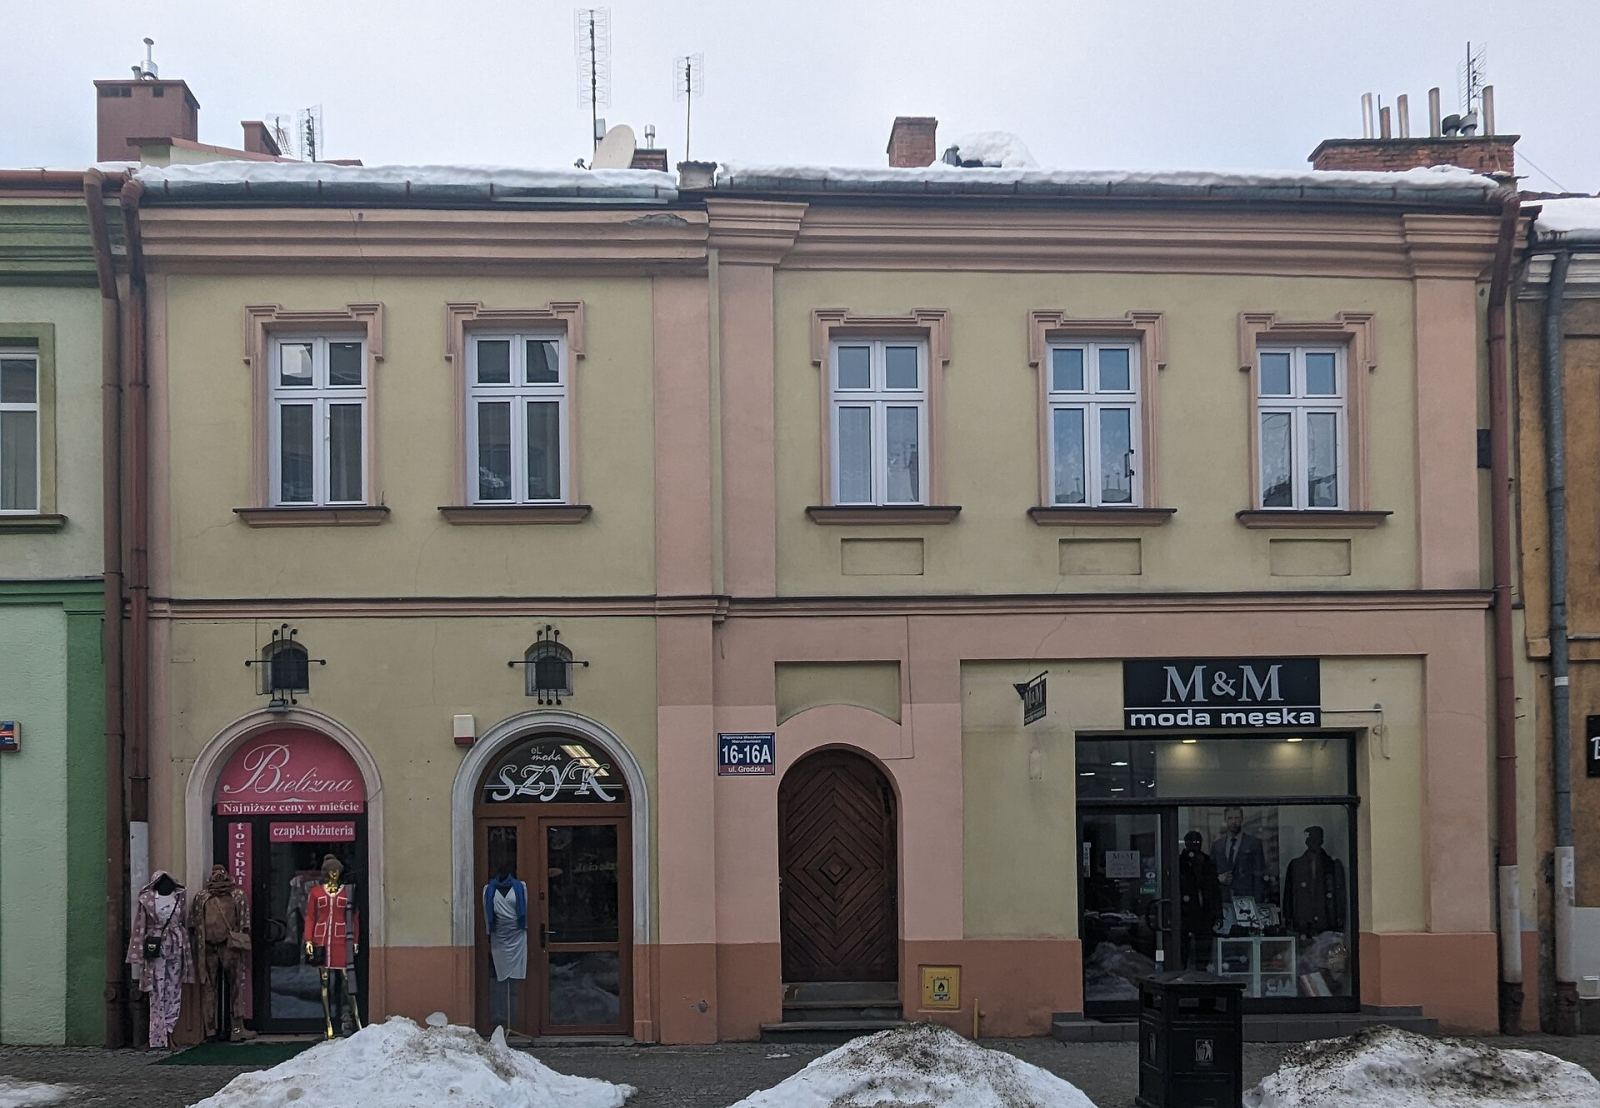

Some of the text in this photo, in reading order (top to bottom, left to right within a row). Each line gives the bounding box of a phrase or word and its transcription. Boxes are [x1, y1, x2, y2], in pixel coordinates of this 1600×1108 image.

[1162, 664, 1285, 703] M&M
[1130, 708, 1315, 728] moda męska
[722, 744, 772, 764] 16-16A
[223, 743, 353, 794] Bielizna
[738, 765, 766, 773] Grodzka
[223, 800, 360, 815] Najniższe ceny w mieście
[273, 825, 354, 839] czapki biżuteria
[234, 823, 246, 886] torebki
